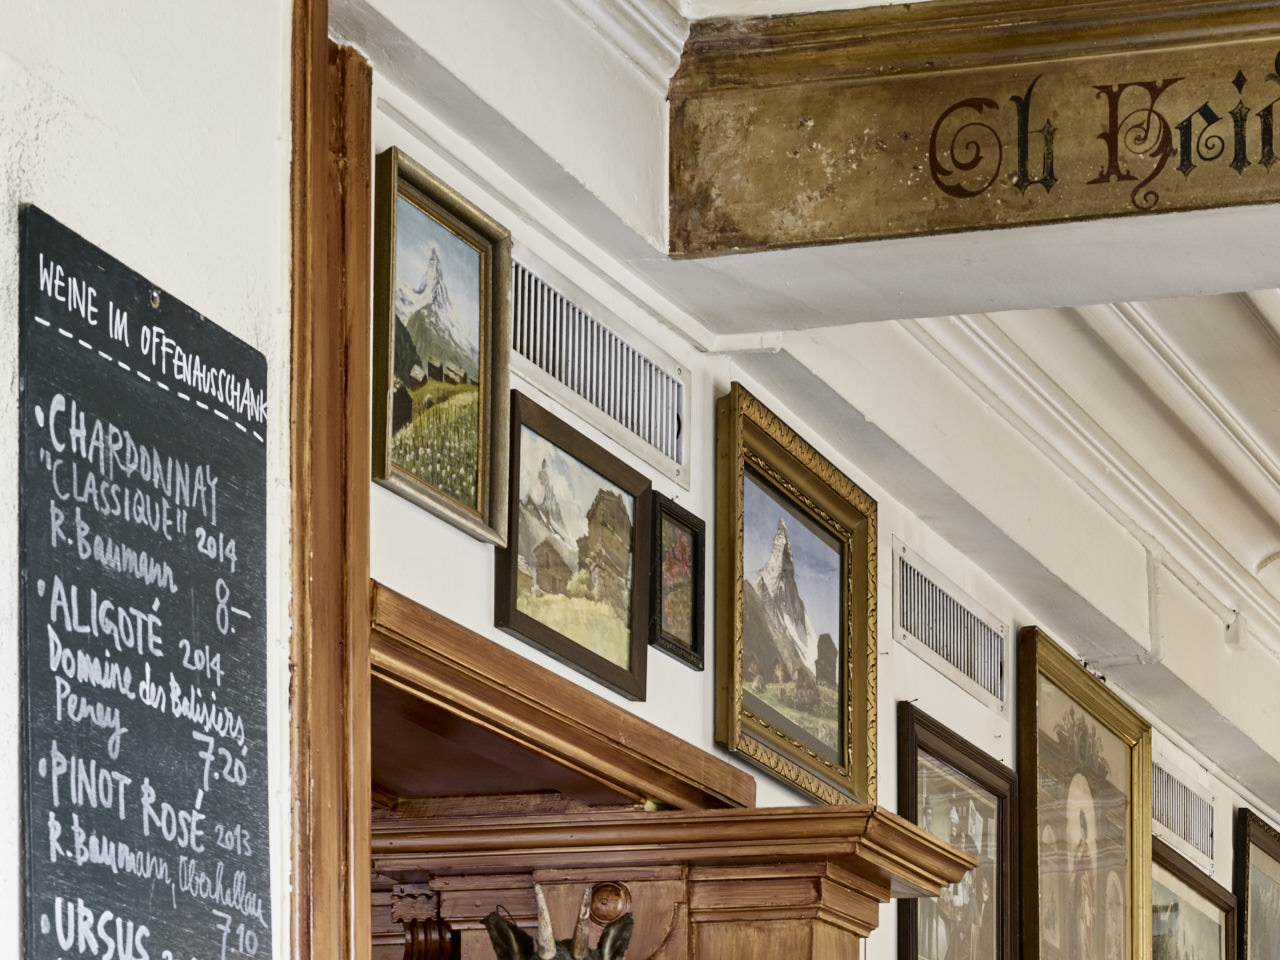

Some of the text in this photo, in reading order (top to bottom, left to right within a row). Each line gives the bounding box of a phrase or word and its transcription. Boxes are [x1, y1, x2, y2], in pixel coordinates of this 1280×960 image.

[39, 253, 268, 423] WEINE IM OFFENAUSSCHANK
[50, 393, 218, 526] CHARDONNAY
[195, 527, 238, 573] 2014
[50, 574, 225, 687] ALIGOTÉ 2014
[139, 662, 165, 713] des
[51, 739, 251, 857] PINOT ROSÉ 2013
[192, 730, 248, 791] 7.20
